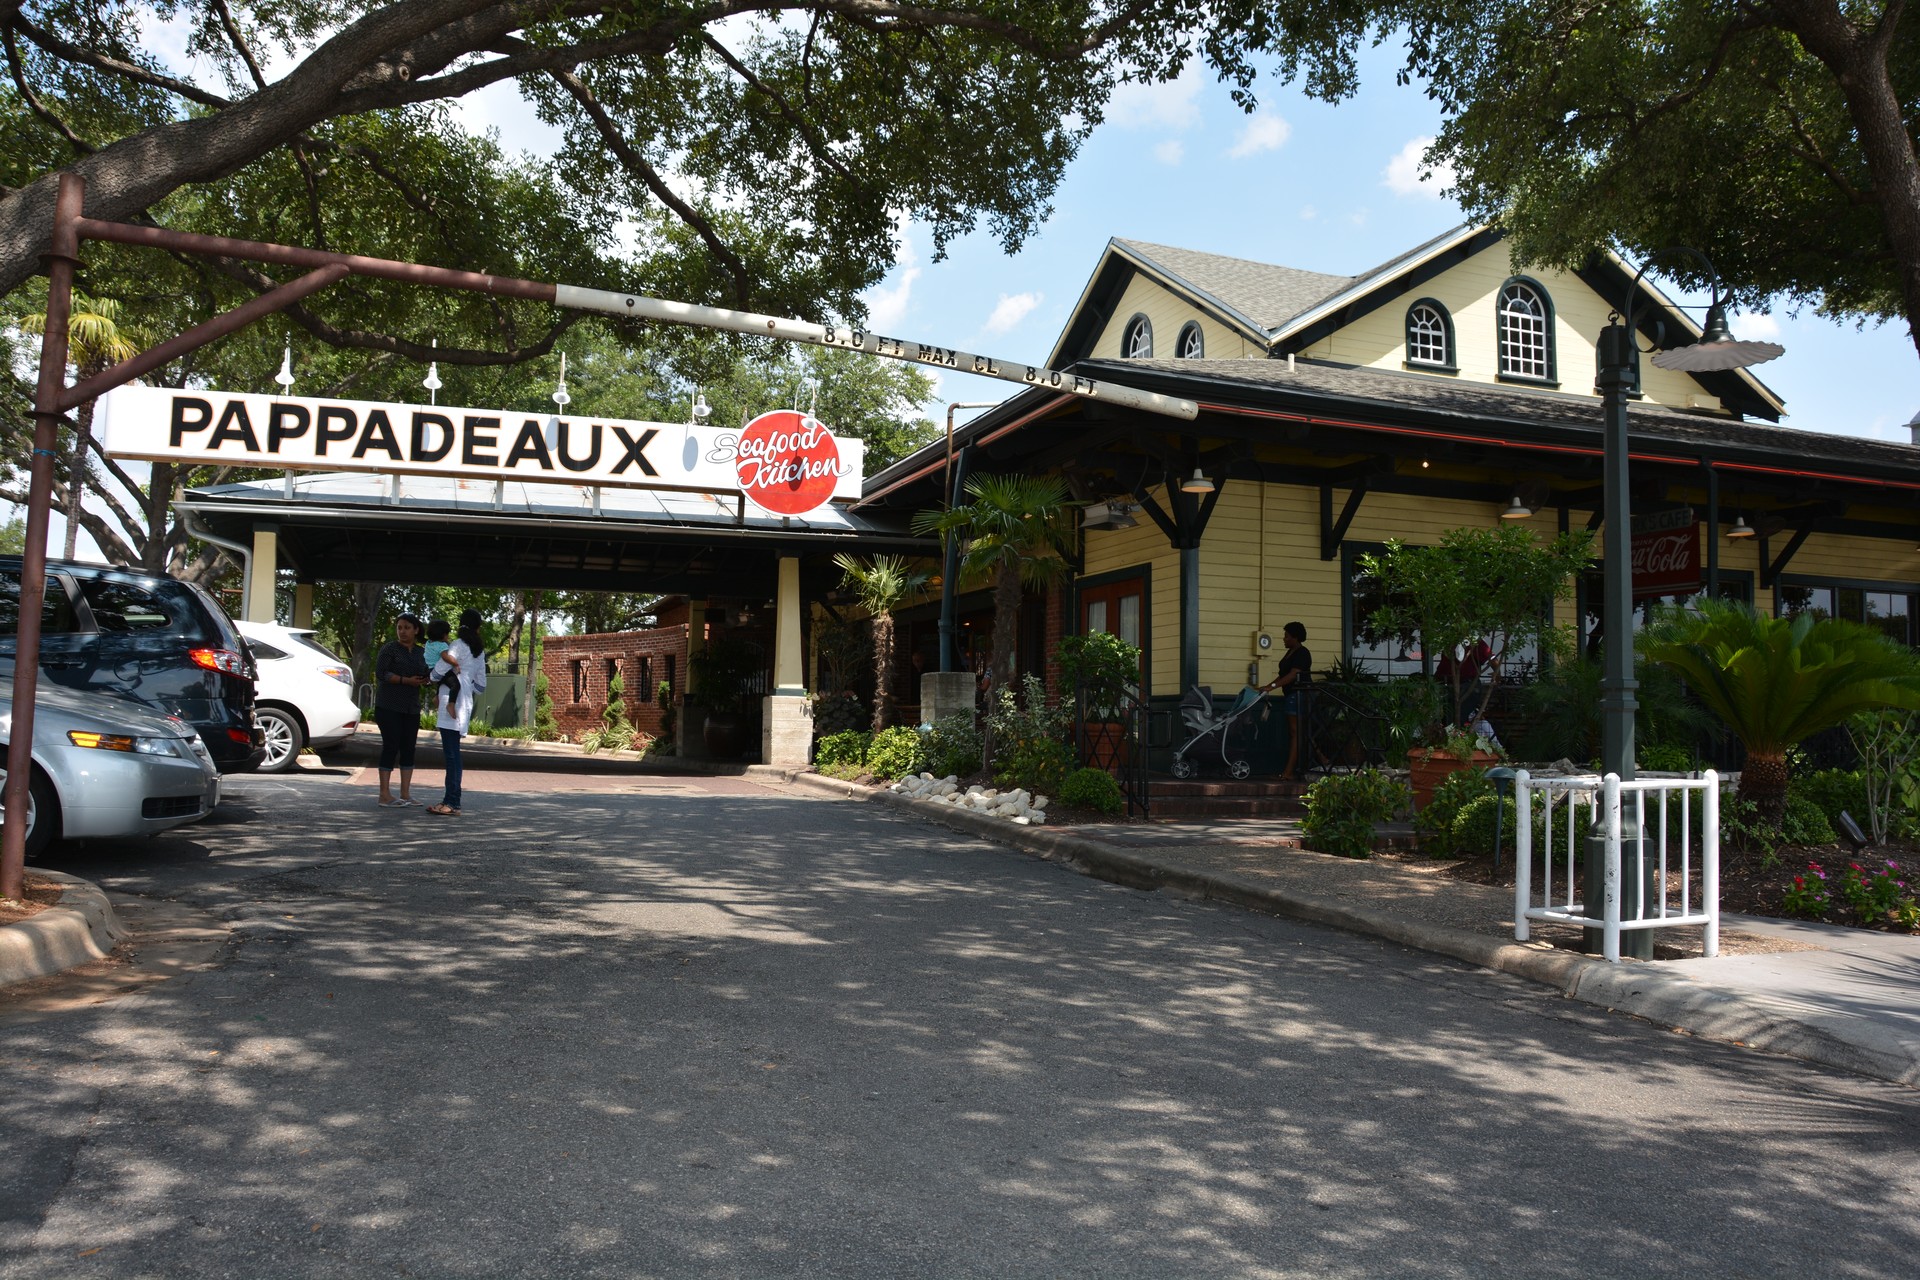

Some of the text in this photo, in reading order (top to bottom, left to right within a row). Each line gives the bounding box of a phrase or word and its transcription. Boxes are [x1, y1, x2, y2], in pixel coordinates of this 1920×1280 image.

[877, 335, 904, 355] FT
[917, 342, 957, 366] MAX
[973, 355, 998, 375] CL
[1072, 375, 1097, 395] FT
[168, 396, 661, 477] PAPPADEAUX
[705, 429, 827, 464] Seafood
[737, 456, 854, 490] Kitchen
[1631, 510, 1690, 532] RK'S CAFE
